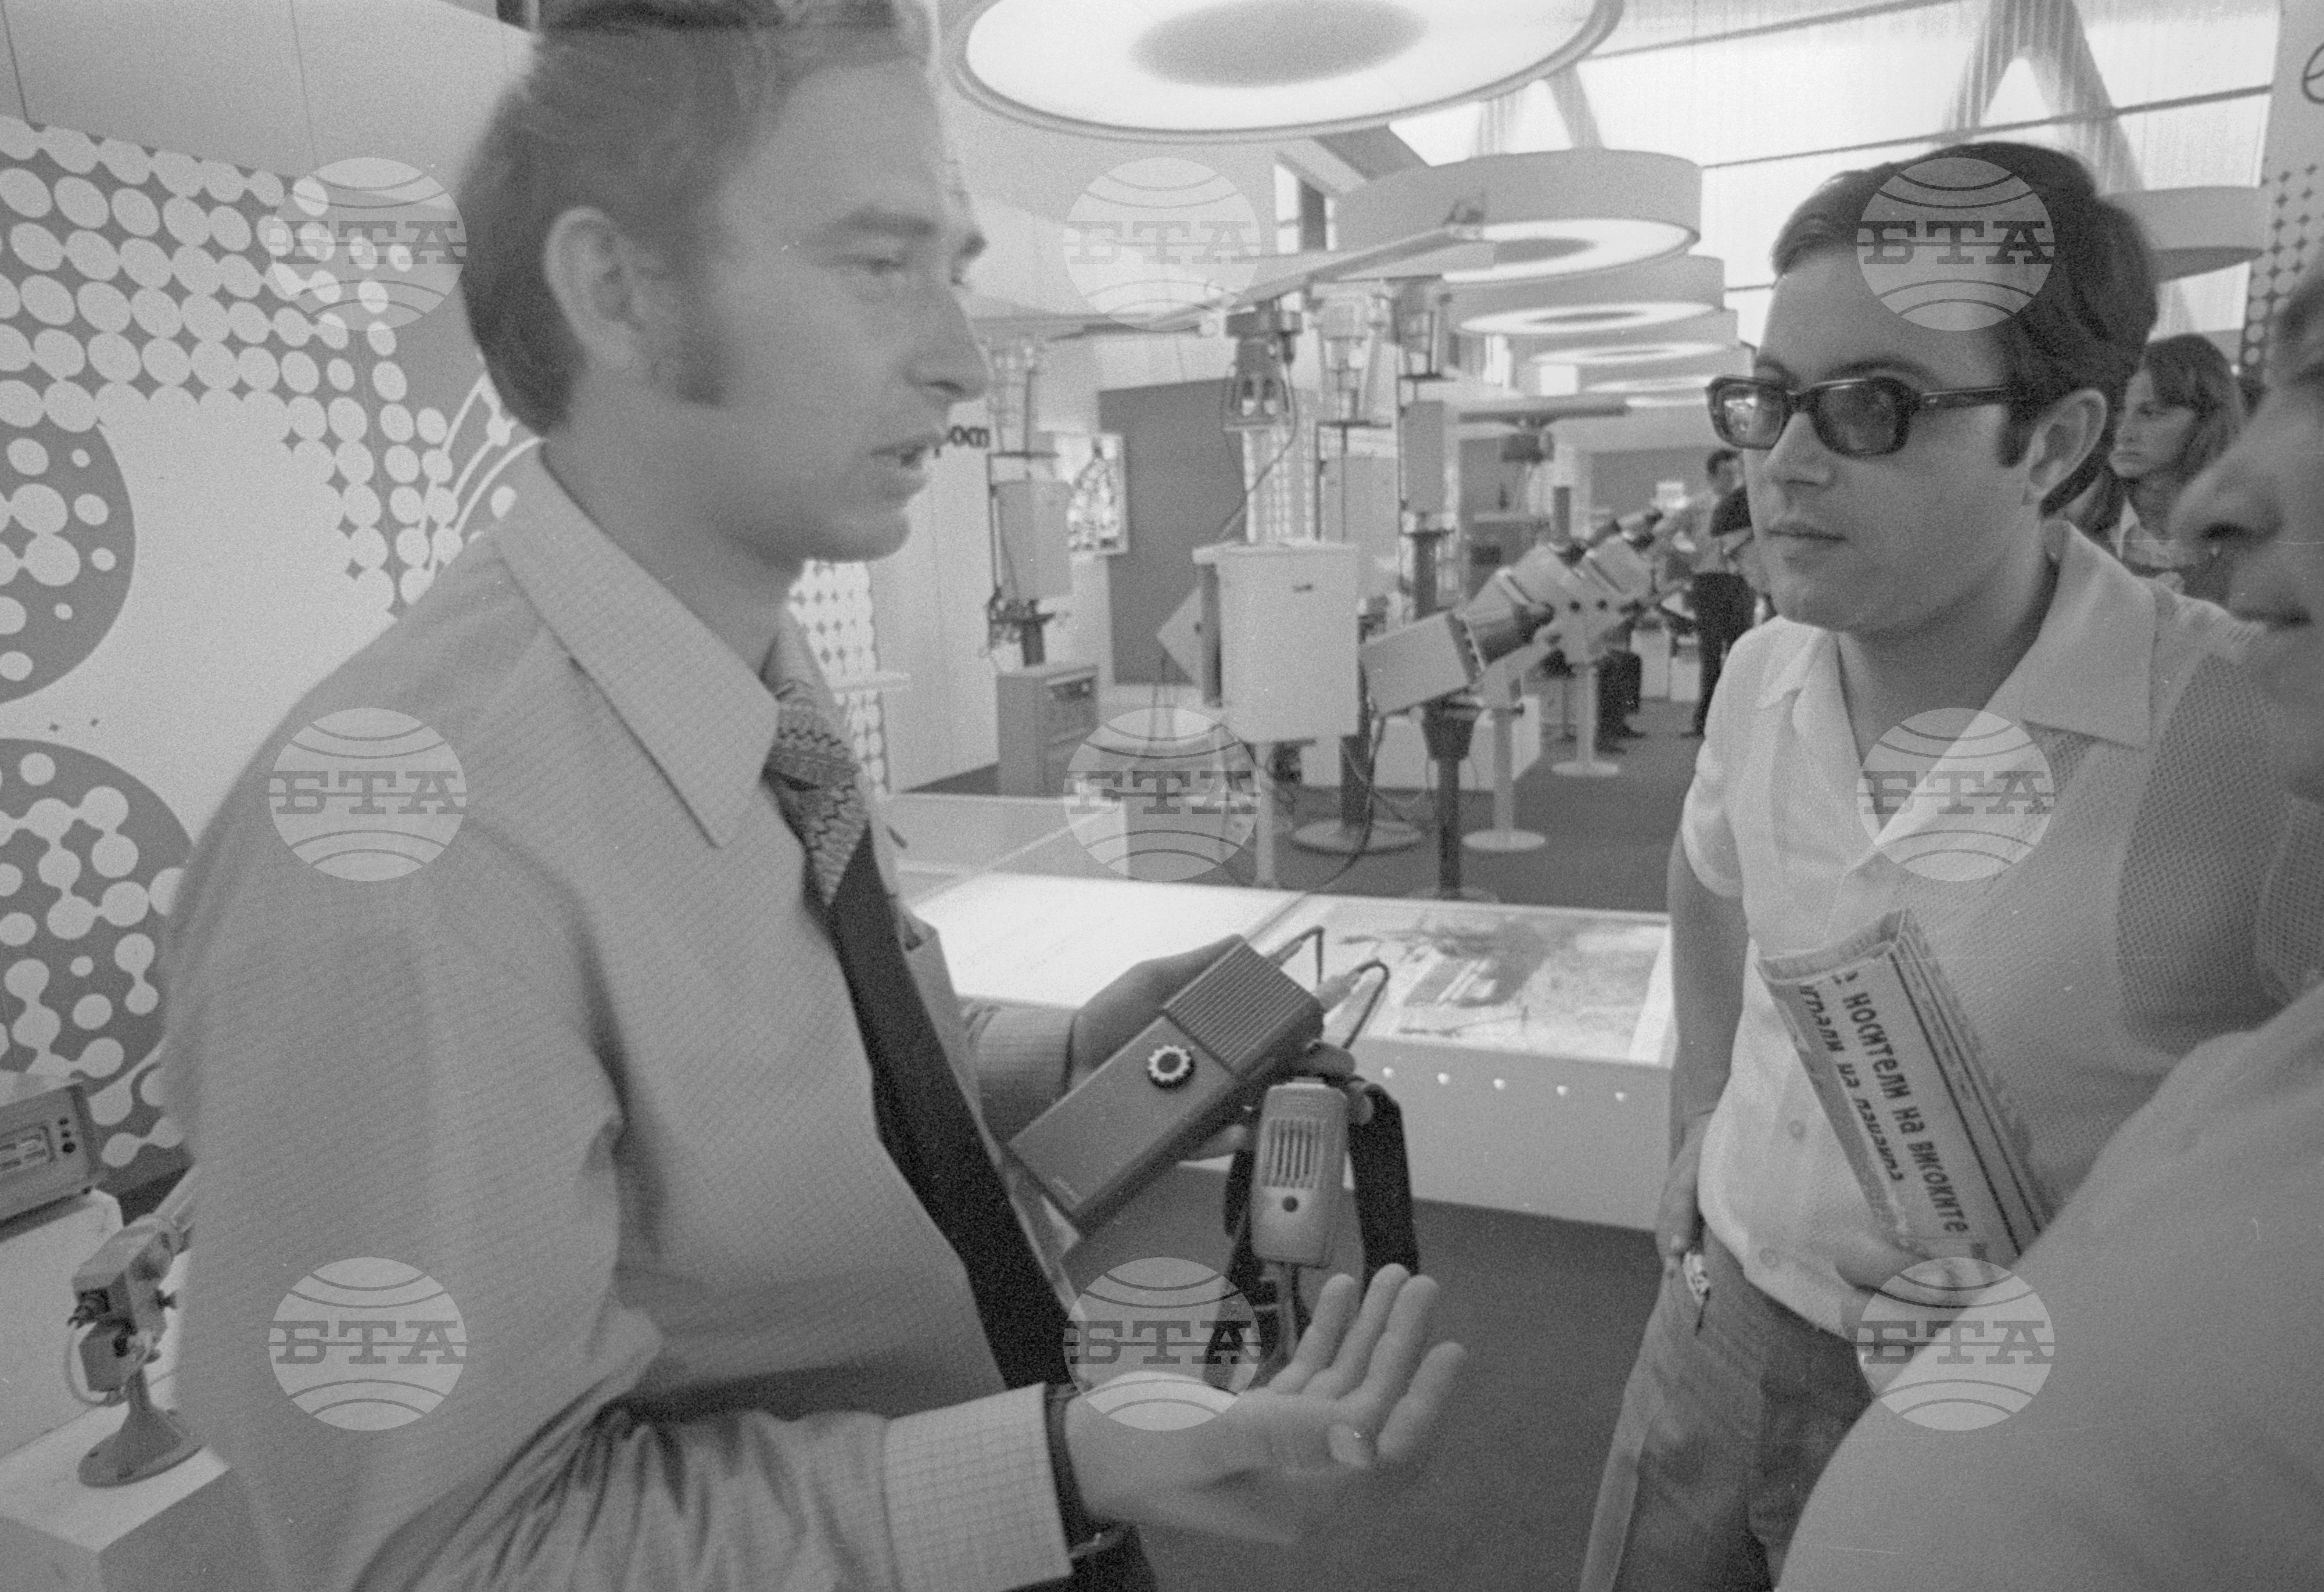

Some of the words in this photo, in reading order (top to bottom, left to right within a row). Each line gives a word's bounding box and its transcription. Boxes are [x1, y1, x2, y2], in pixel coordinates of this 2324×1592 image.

[1842, 991, 1911, 1099] носители
[1892, 1106, 1925, 1134] на
[1907, 1141, 1969, 1232] високите
